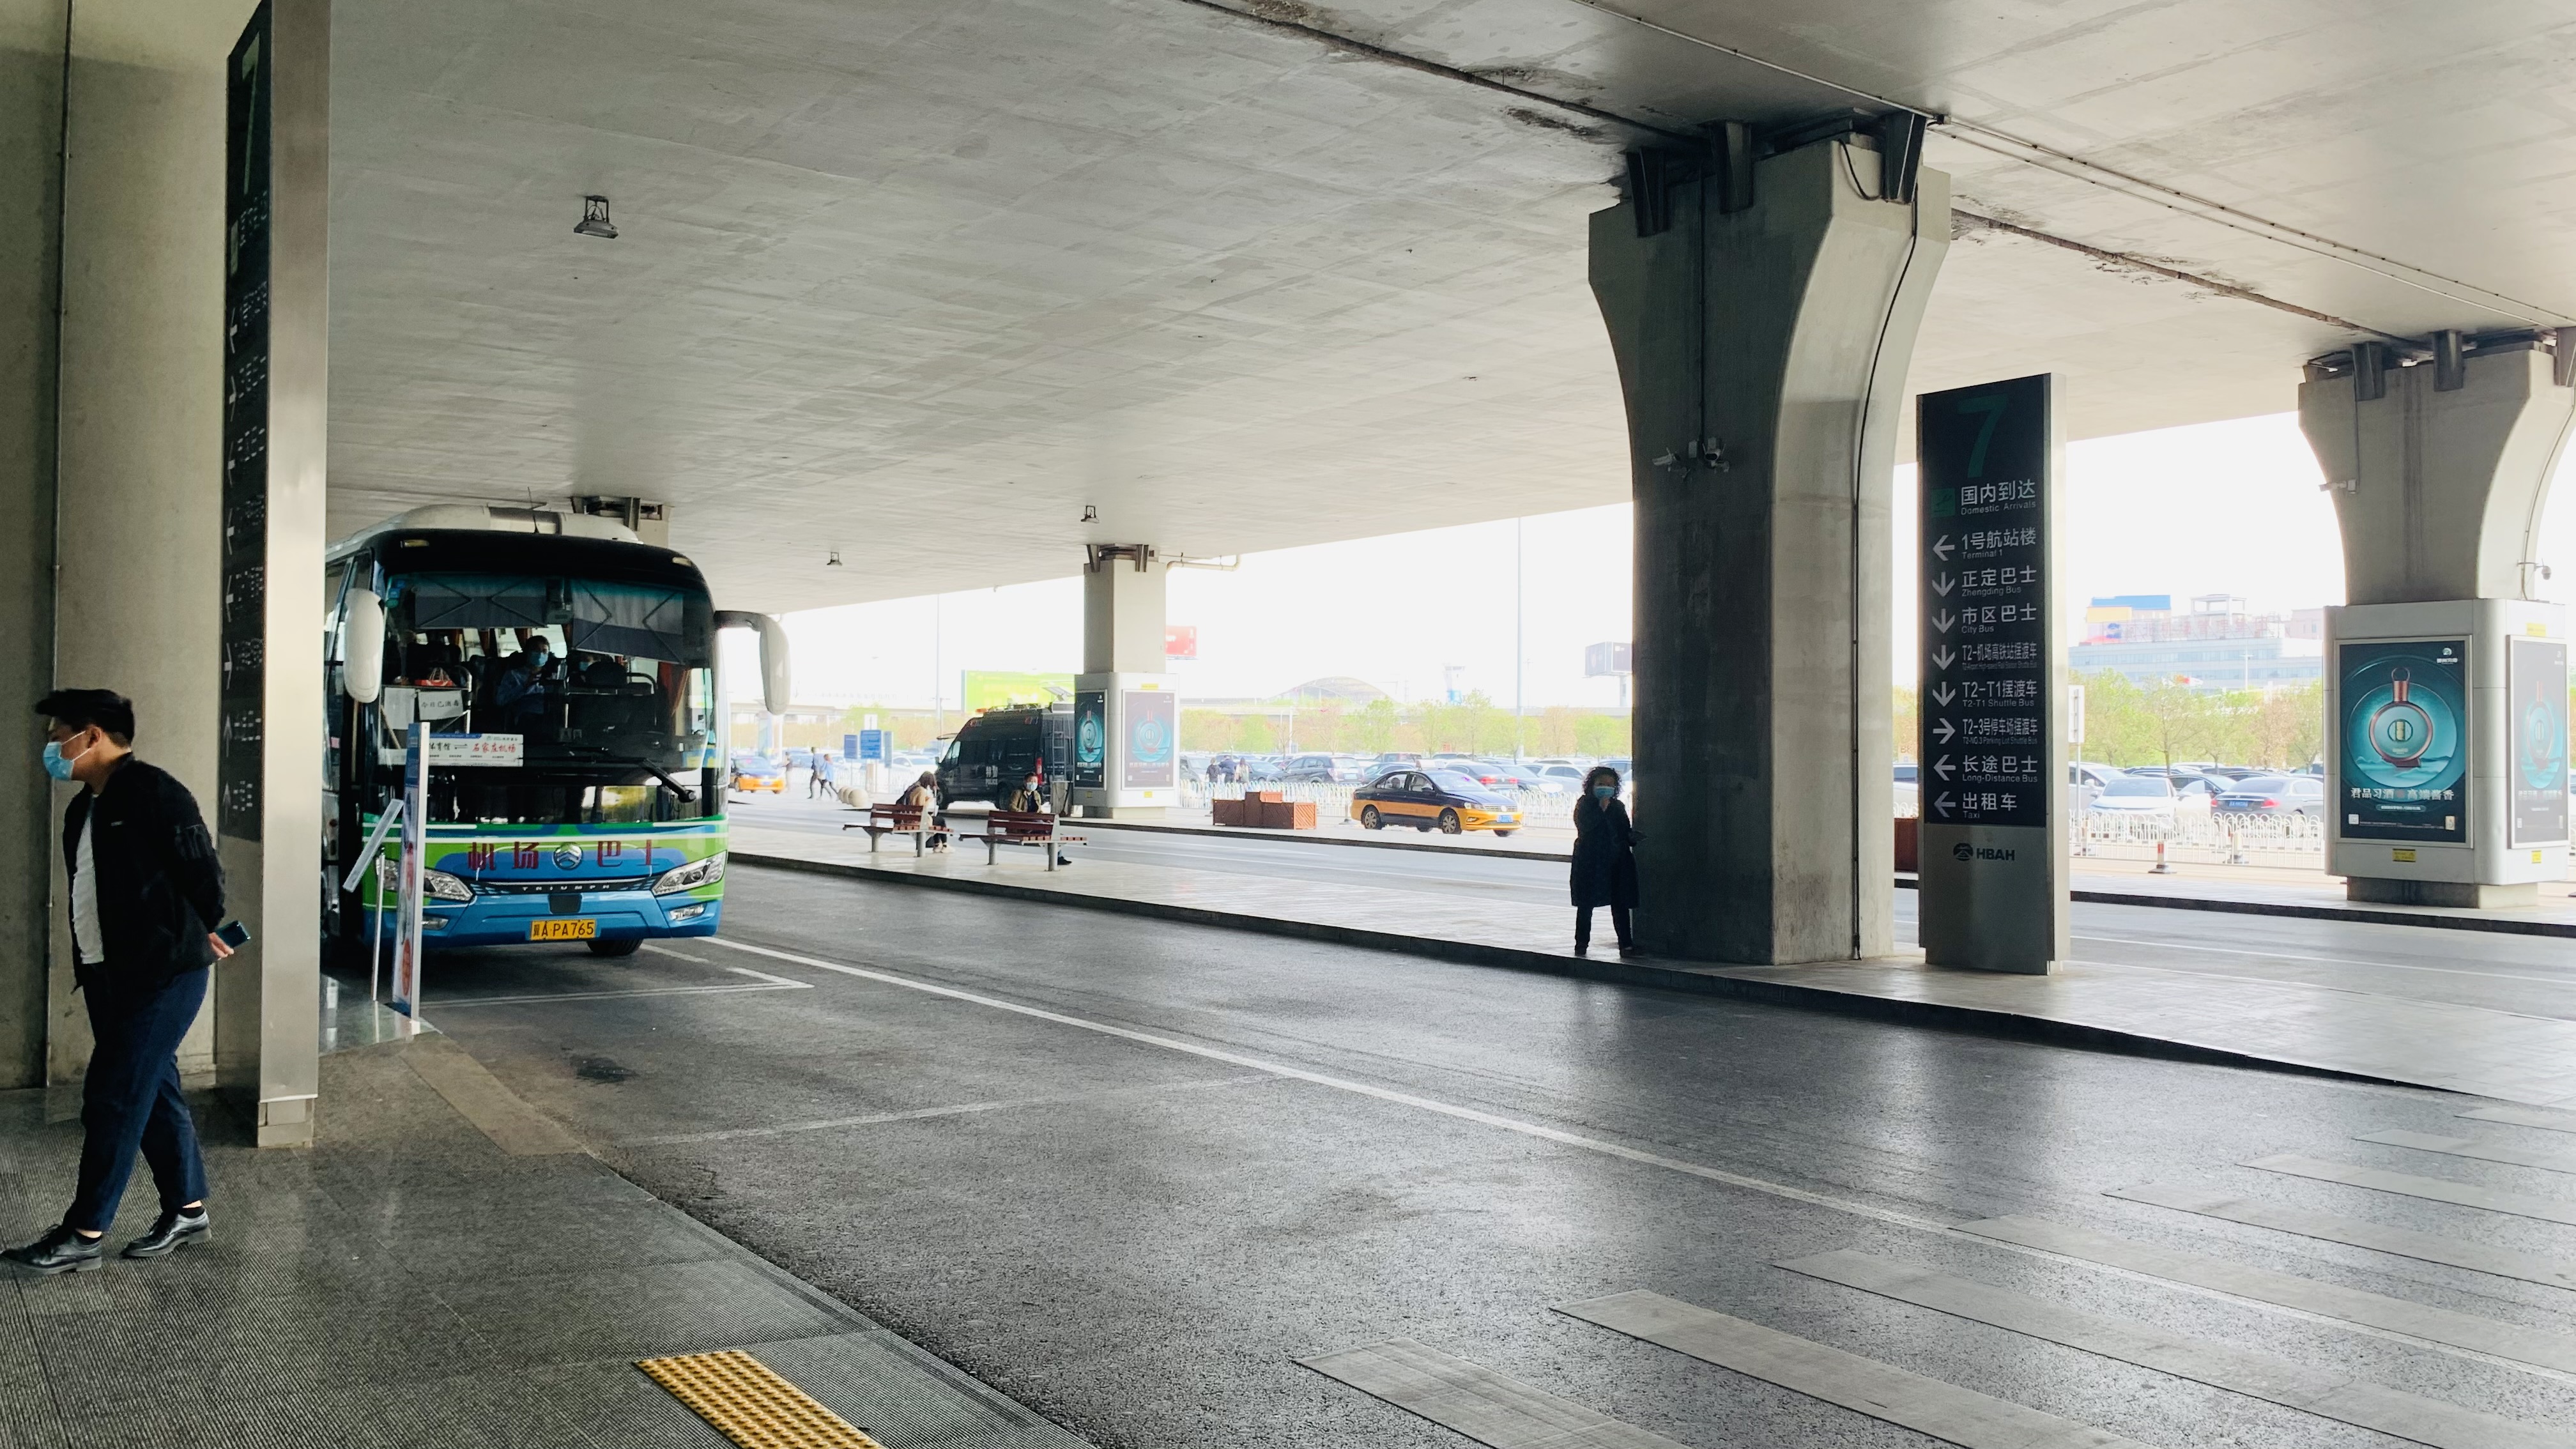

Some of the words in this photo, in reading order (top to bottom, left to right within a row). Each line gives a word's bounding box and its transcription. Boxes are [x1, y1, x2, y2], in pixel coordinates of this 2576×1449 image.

[1958, 393, 2009, 479] 7
[1961, 479, 2036, 505] 国内到达
[1961, 504, 2000, 515] Domestic
[2004, 500, 2036, 510] Arrivals
[1961, 526, 2037, 550] 1号航站楼
[1962, 550, 1997, 560] Terminal
[1961, 565, 2037, 588] 正定巴士
[1961, 586, 2004, 597] Zhengding
[2006, 586, 2021, 594] Bus
[1961, 602, 2037, 625] 市区巴士
[1961, 625, 1977, 634] City
[1979, 625, 1995, 633] Bus
[1962, 679, 2037, 698] T2-T1摆渡车
[1988, 698, 2017, 707] Shuttle
[2019, 698, 2035, 707] Bus
[1963, 755, 2038, 774] 长途巴士
[1963, 774, 2020, 783] Long-Distance
[2022, 774, 2038, 783] Bus
[1963, 792, 2018, 811] 出租车
[2350, 787, 2395, 799] 君品习酒
[467, 841, 539, 871] 机场
[597, 839, 661, 868] 巴士
[1976, 847, 2016, 861] HBAH
